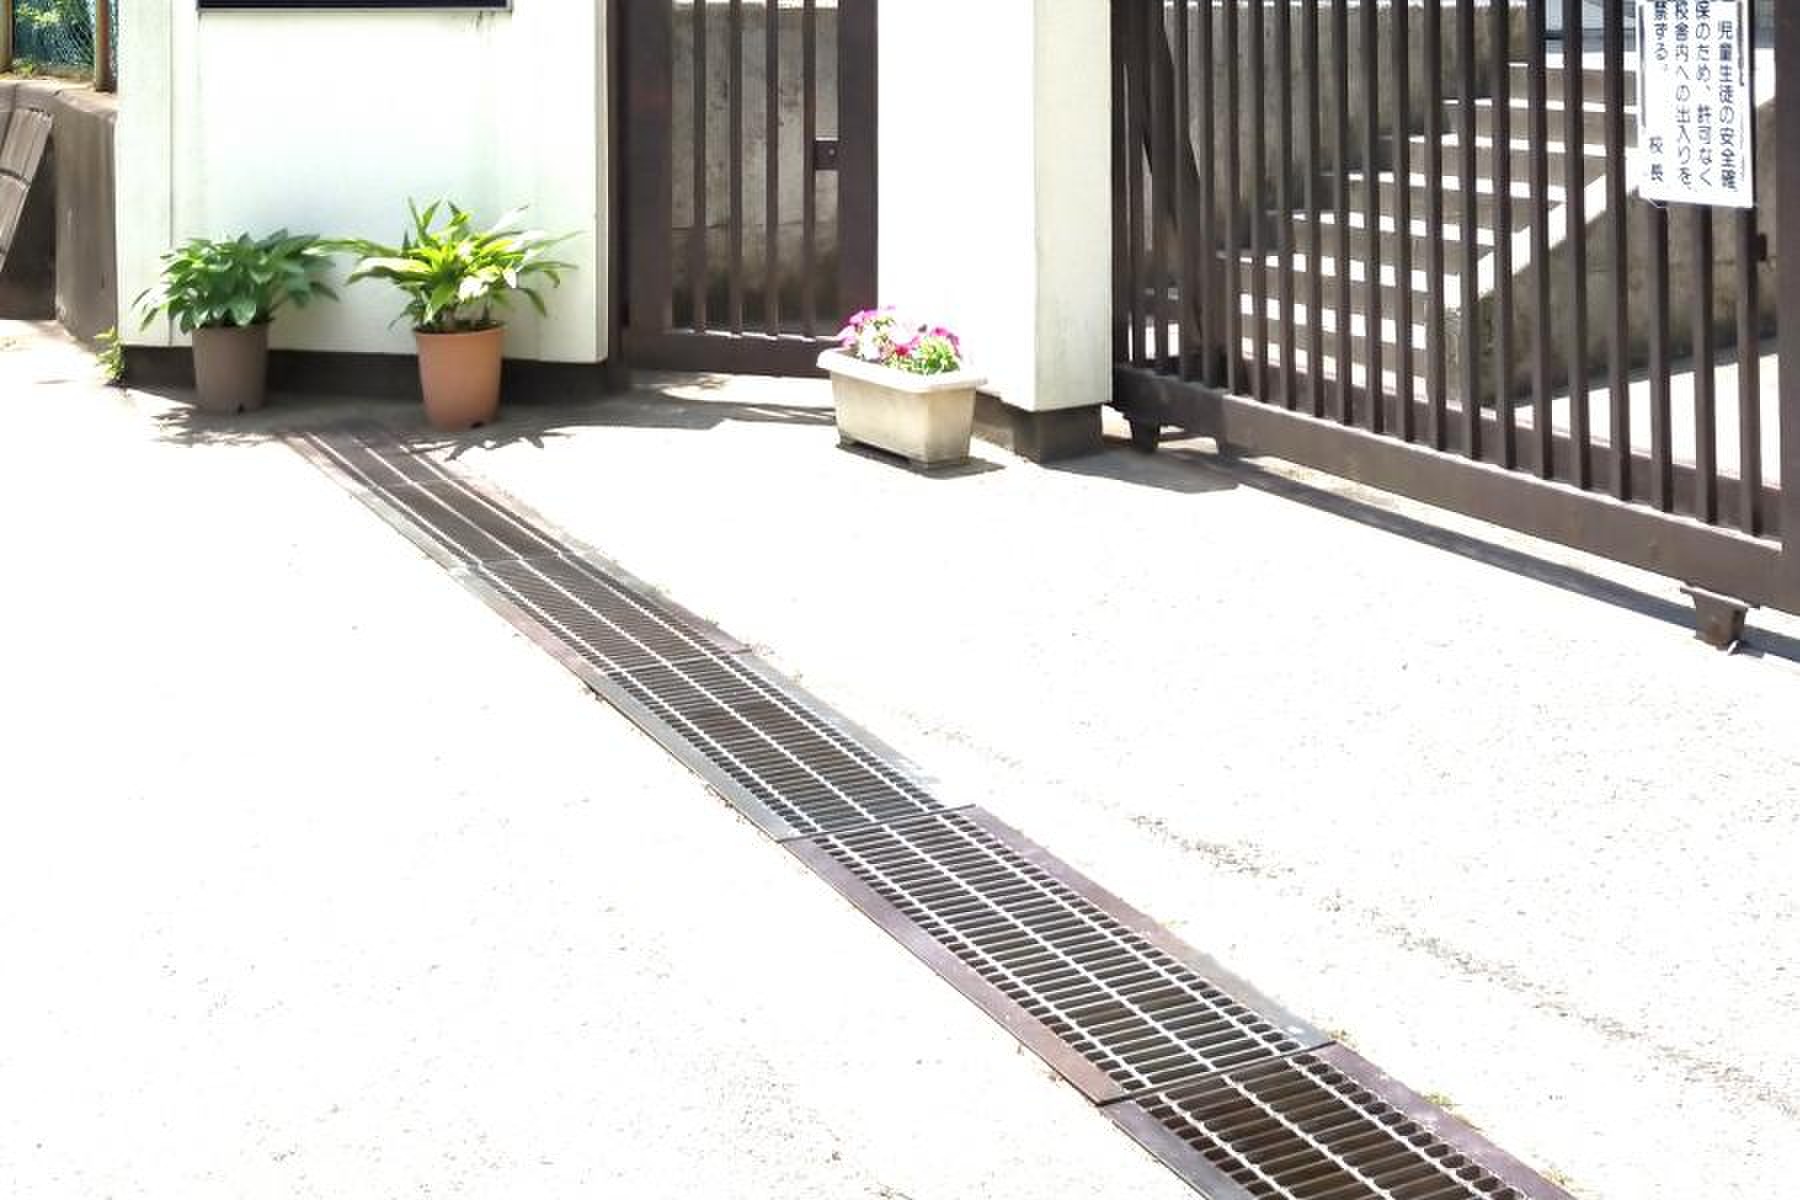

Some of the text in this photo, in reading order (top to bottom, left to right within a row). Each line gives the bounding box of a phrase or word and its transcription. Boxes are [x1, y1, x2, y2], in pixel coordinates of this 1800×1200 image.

[1649, 136, 1664, 182] 校長
[1717, 20, 1738, 191] 児童生徒の安全確
